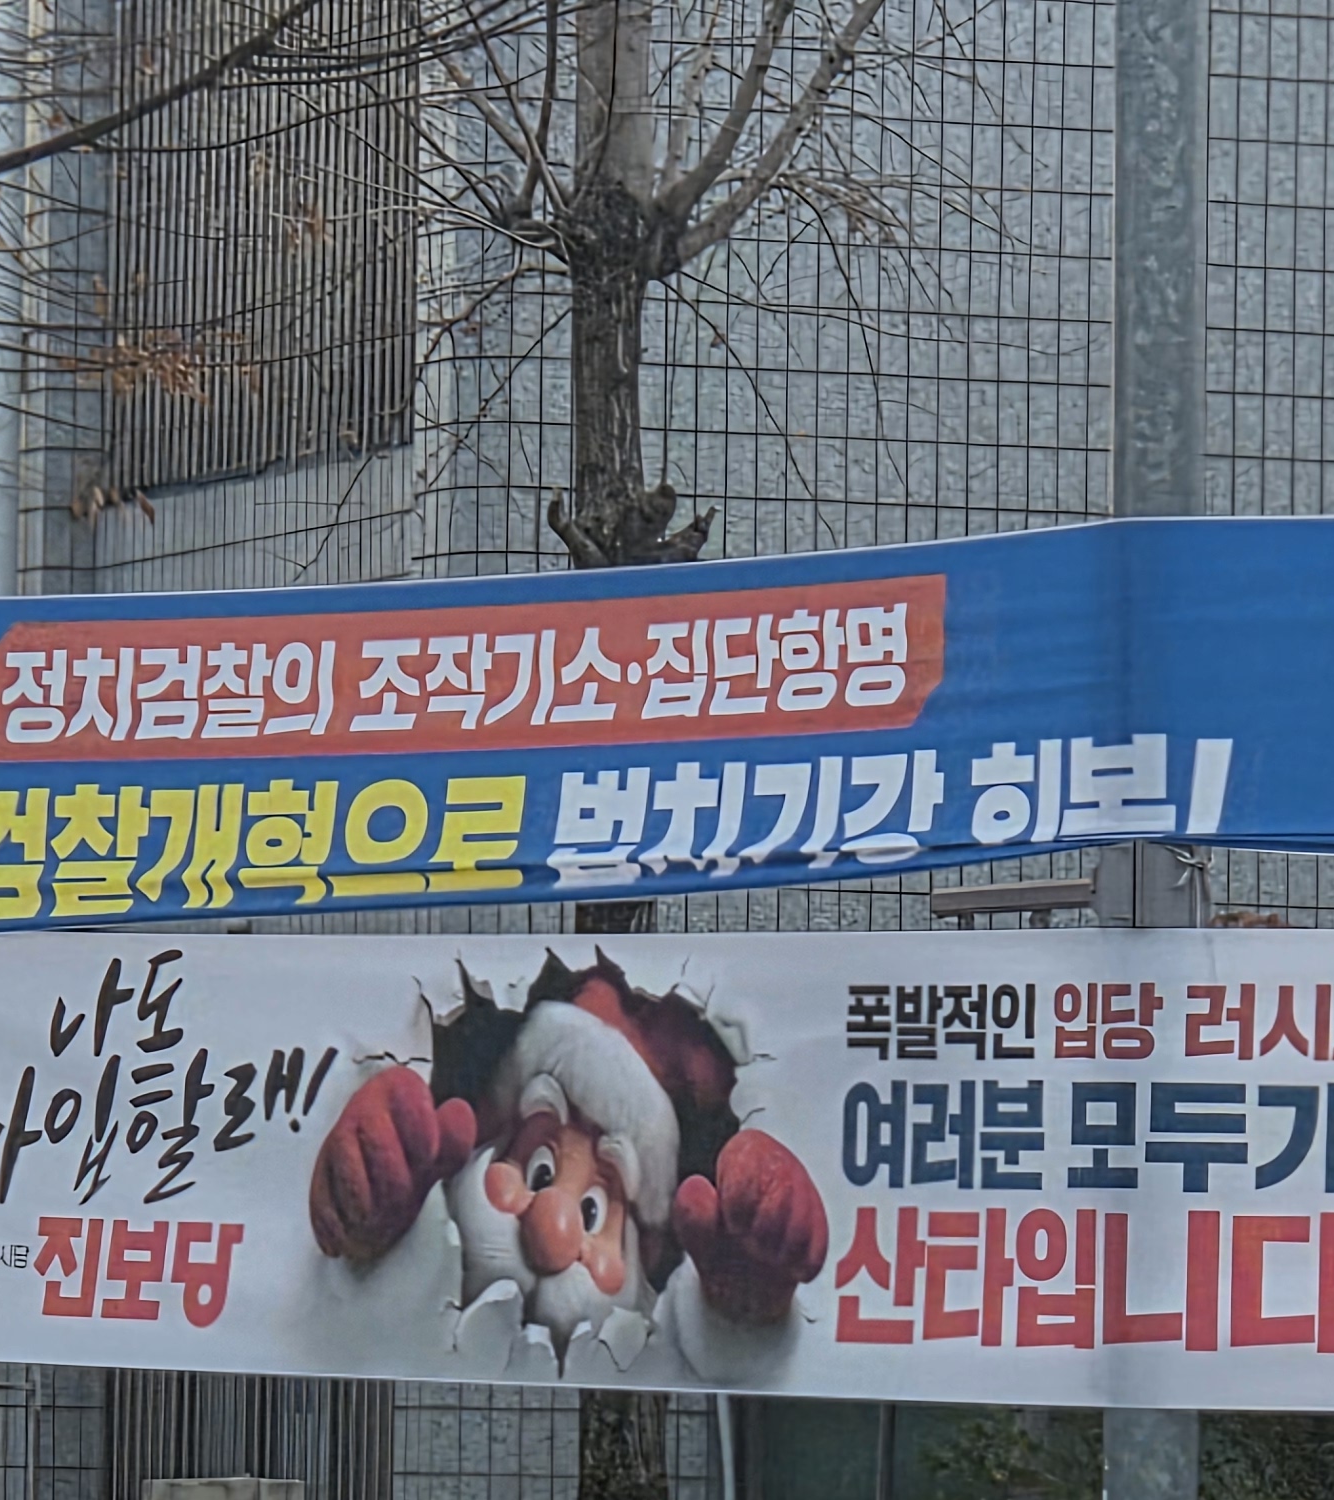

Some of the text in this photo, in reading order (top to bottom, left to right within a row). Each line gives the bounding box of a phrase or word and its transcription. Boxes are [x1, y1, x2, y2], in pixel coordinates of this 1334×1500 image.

[1, 602, 908, 743] 정치검찰의 조작기소·집단항명
[50, 949, 183, 1057] 나도
[846, 983, 1036, 1061] 폭발적인
[1054, 982, 1164, 1061] 입당
[841, 1079, 1046, 1191] 여러분
[34, 1216, 244, 1328] 진보당
